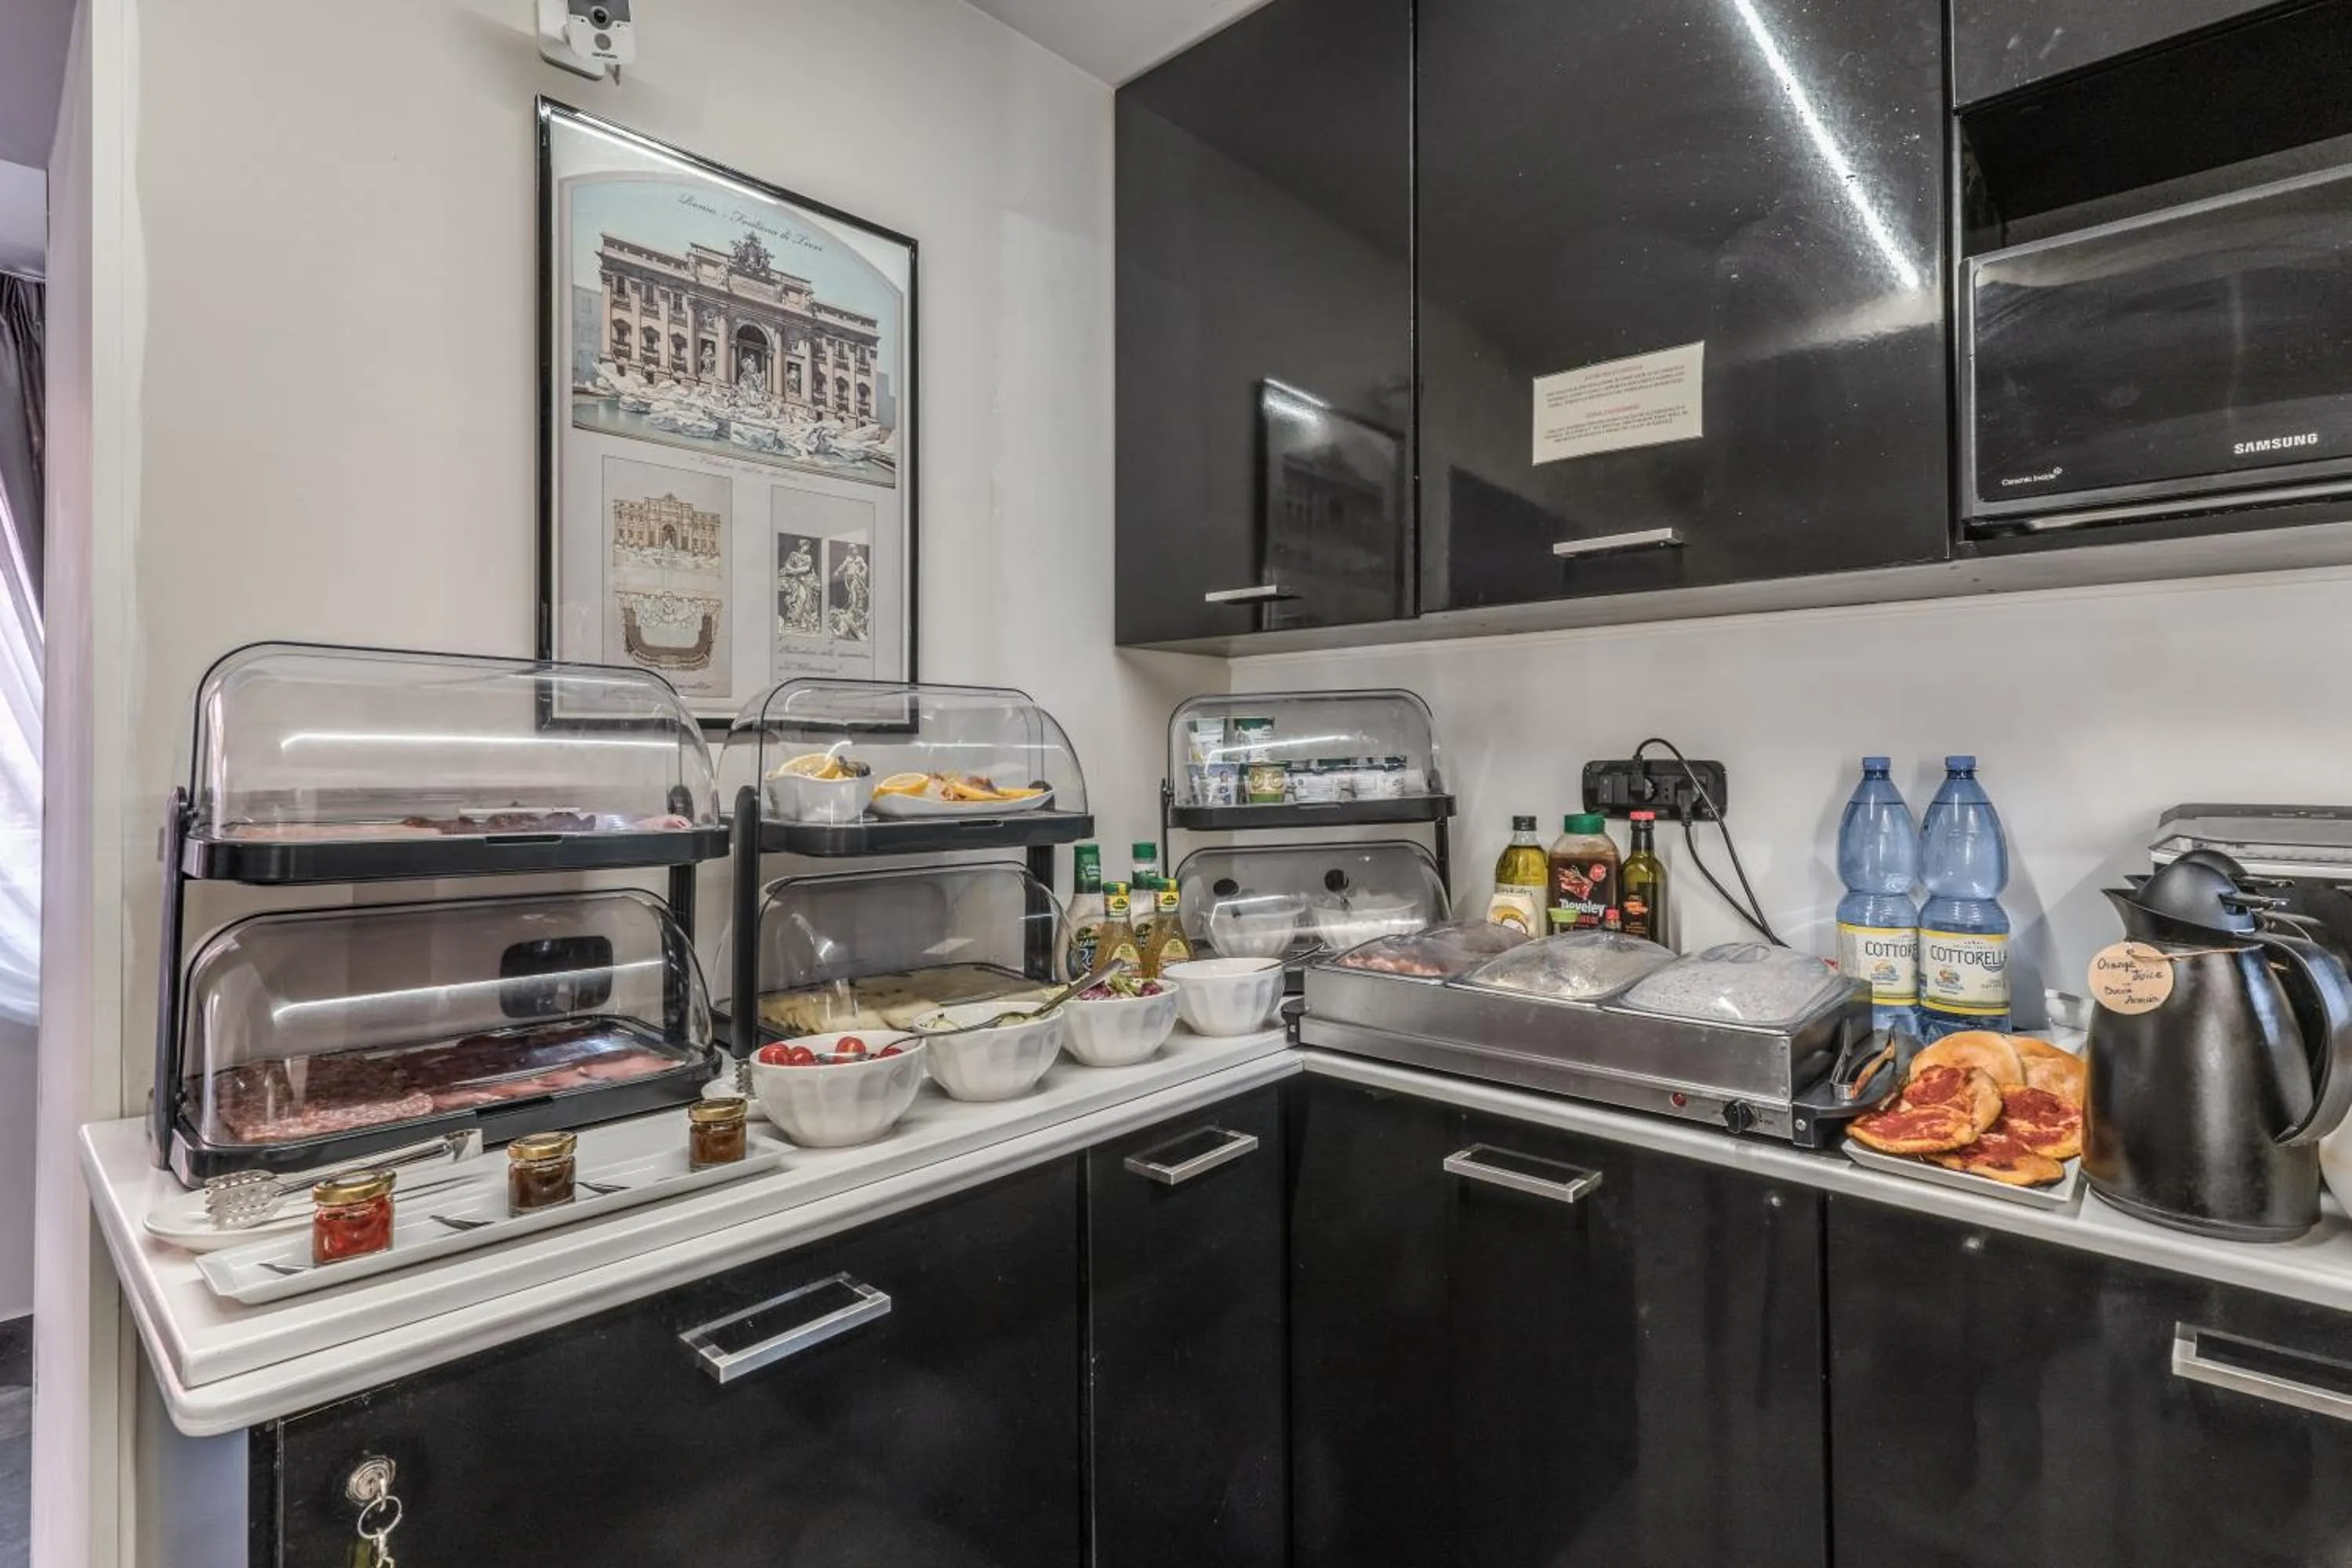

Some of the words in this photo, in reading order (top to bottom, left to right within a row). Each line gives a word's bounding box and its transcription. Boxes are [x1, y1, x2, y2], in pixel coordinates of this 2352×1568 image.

[2234, 433, 2318, 455] SAMSUNG
[1865, 940, 1918, 958] COTTOR
[2097, 957, 2136, 972] Orange
